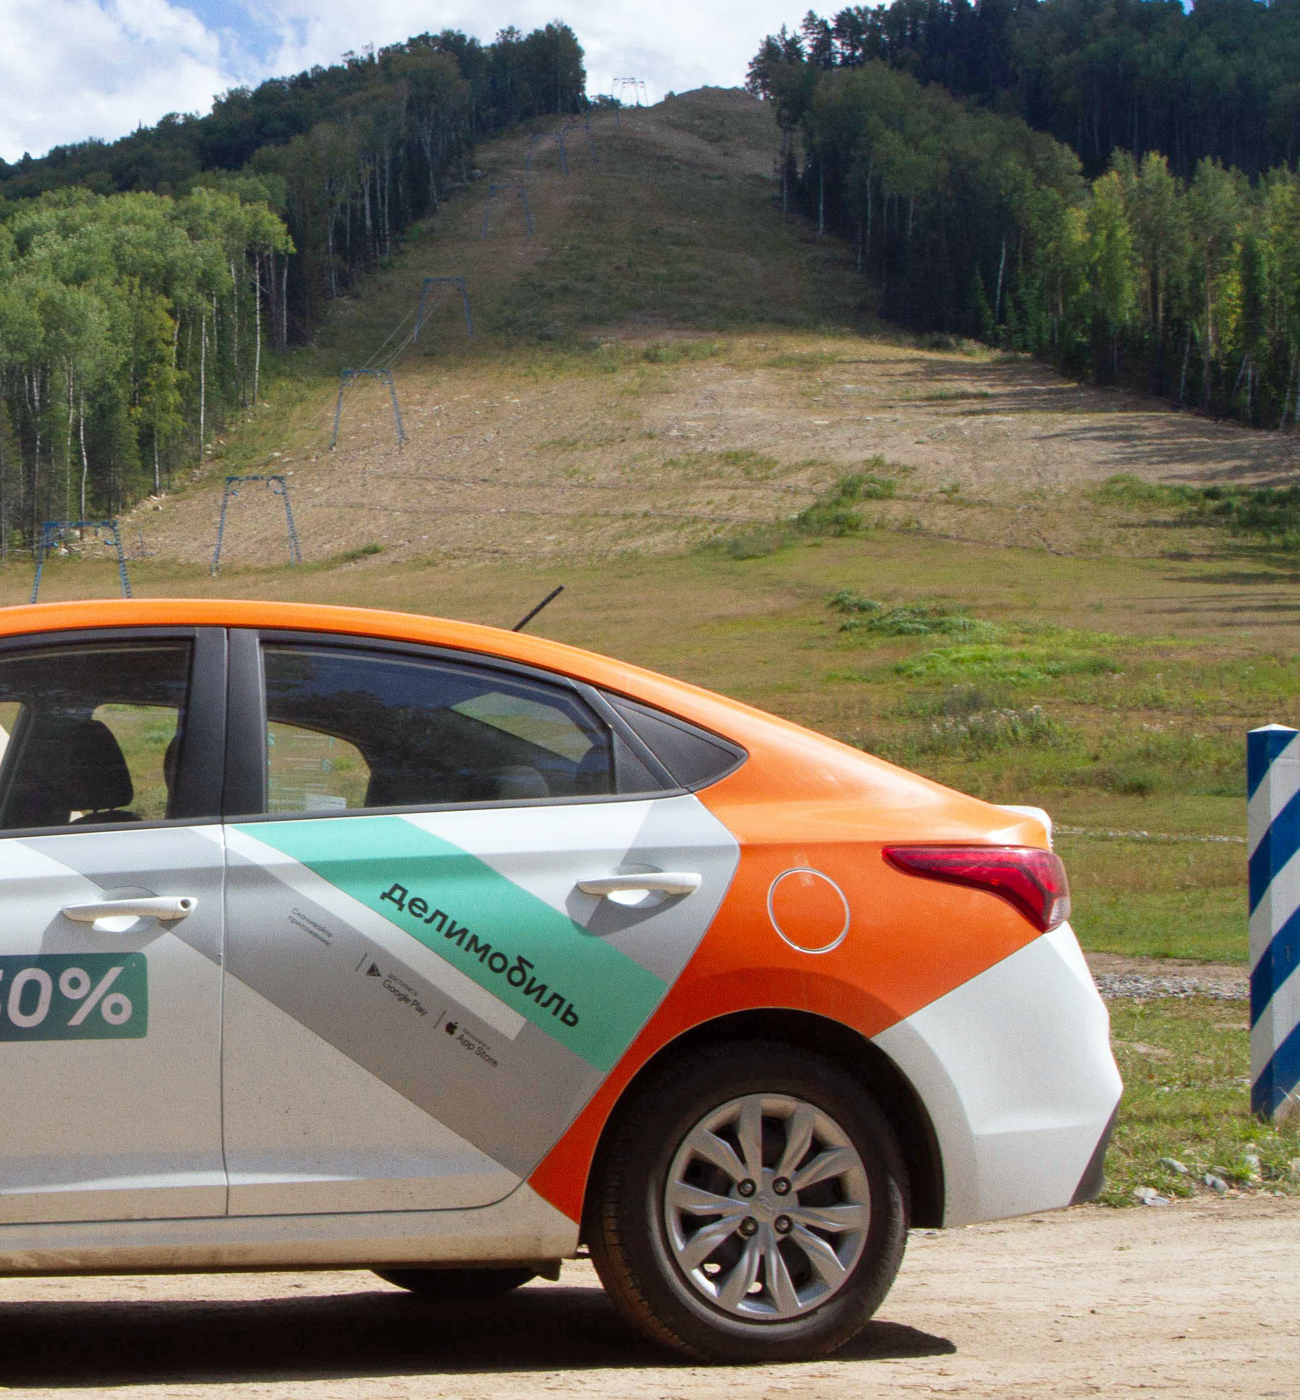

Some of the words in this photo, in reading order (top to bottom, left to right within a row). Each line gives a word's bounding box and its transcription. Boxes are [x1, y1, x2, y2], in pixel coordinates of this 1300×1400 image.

[380, 883, 579, 1027] делимобиль
[383, 979, 411, 1004] Google
[457, 1034, 475, 1051] App
[475, 1046, 498, 1068] Store
